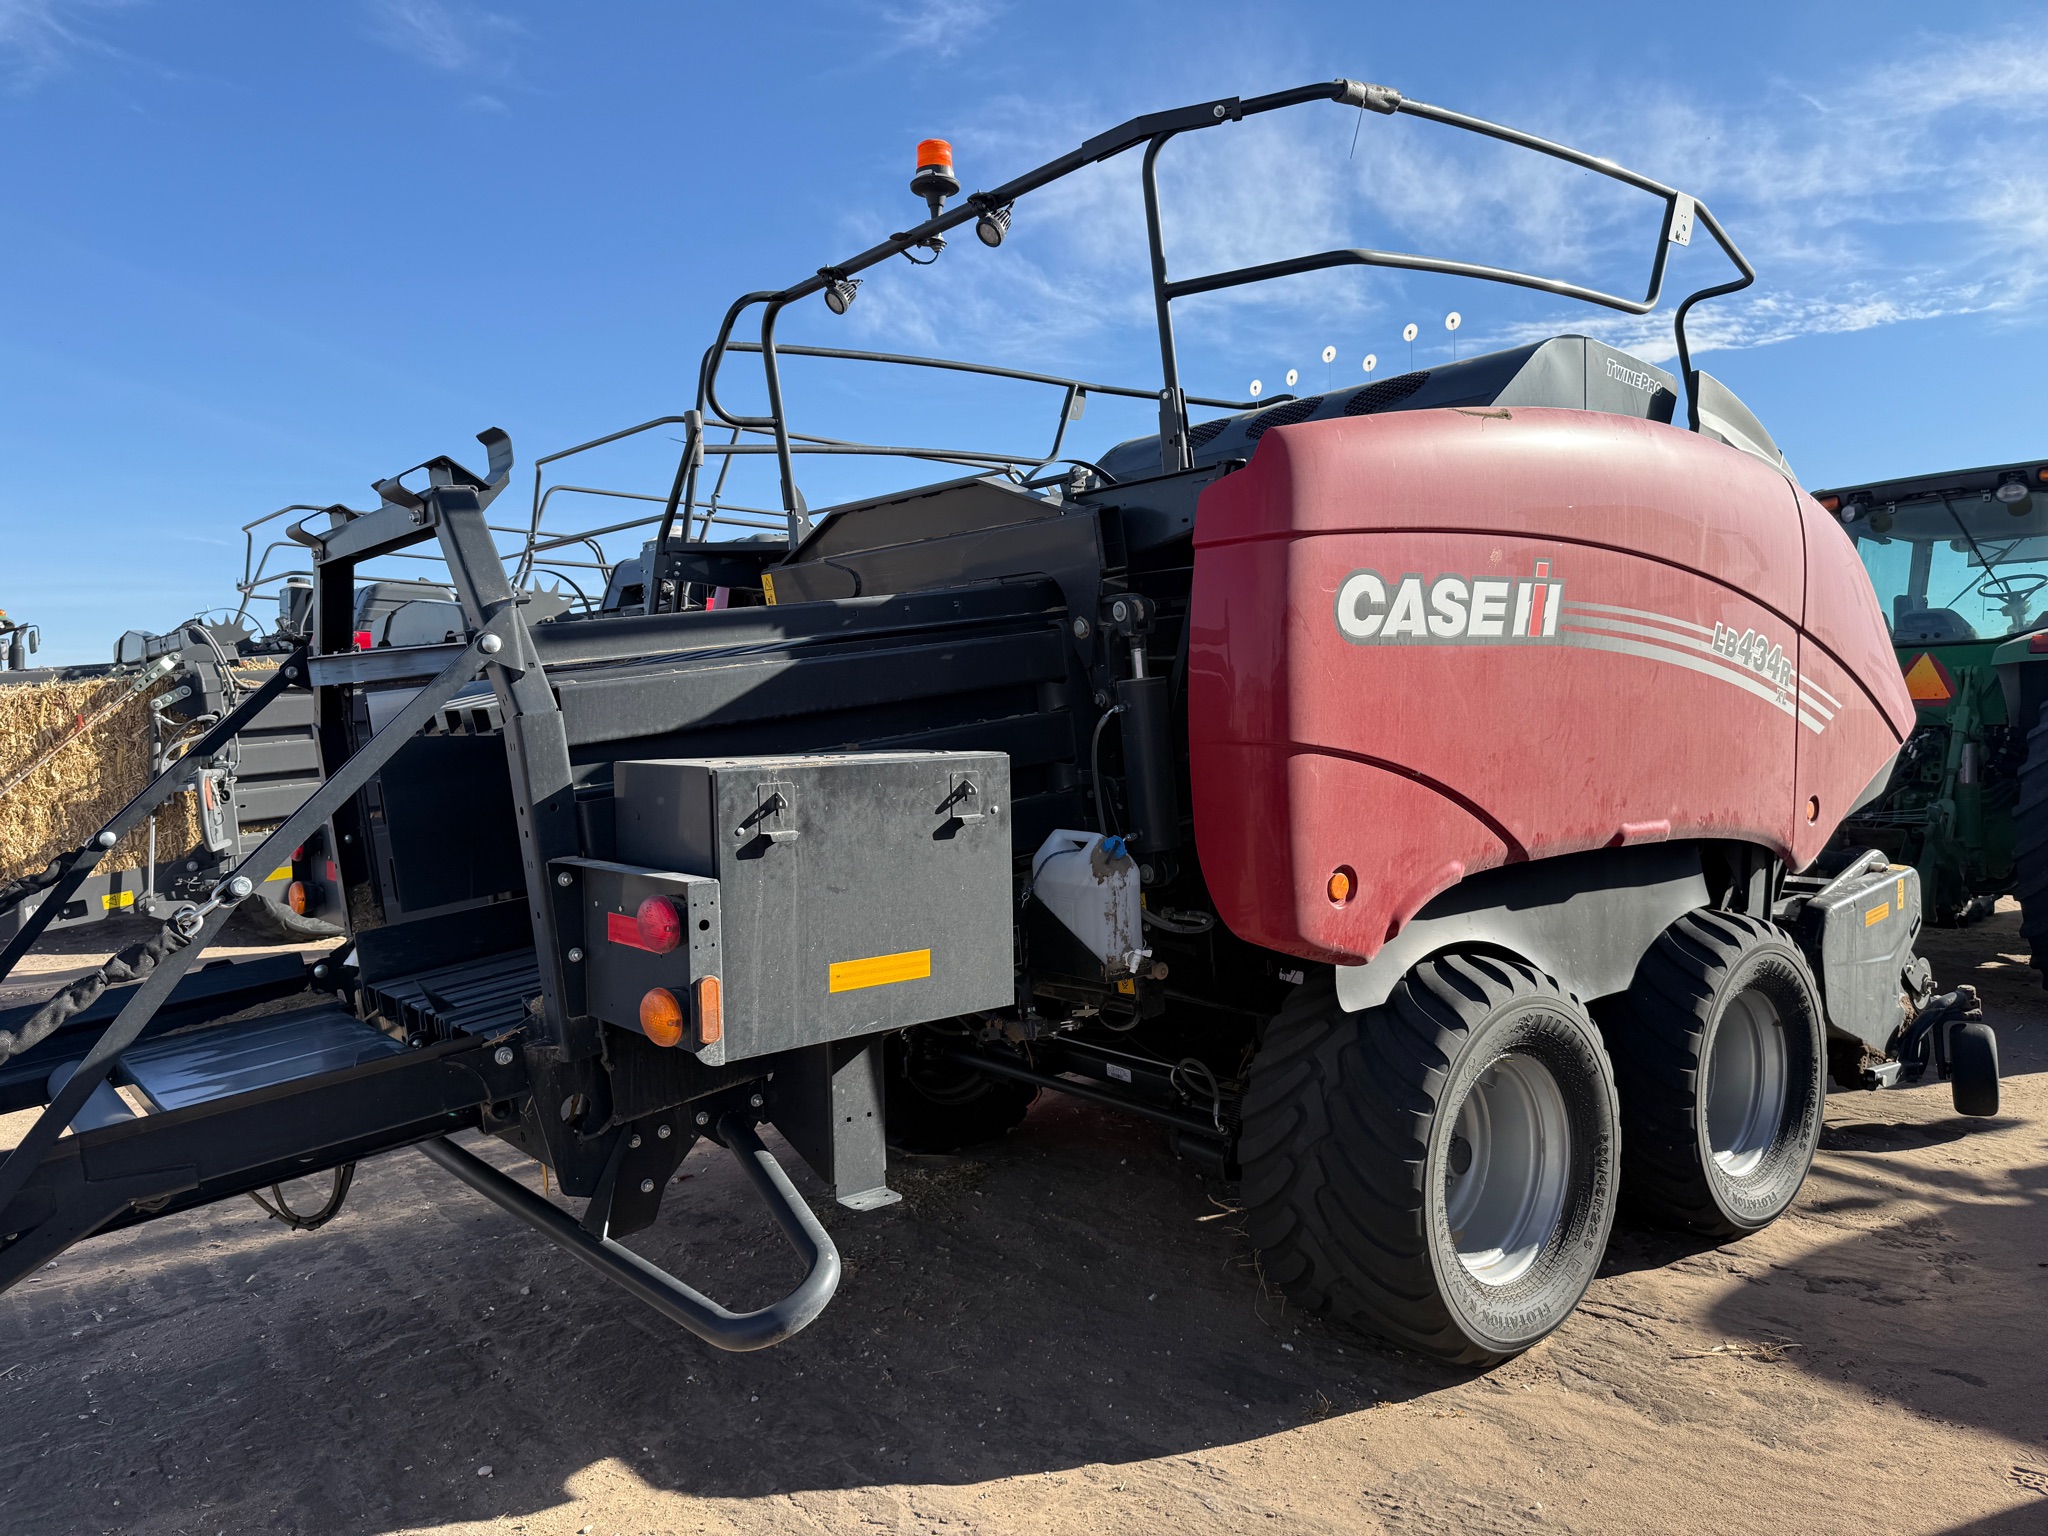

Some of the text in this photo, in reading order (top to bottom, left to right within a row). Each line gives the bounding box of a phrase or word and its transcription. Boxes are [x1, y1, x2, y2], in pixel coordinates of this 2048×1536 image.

[1338, 574, 1510, 638] CASE
[1712, 621, 1792, 688] LB434R
[1522, 1013, 1599, 1079] ALLIANCE
[1481, 1302, 1552, 1330] FLOTATION
